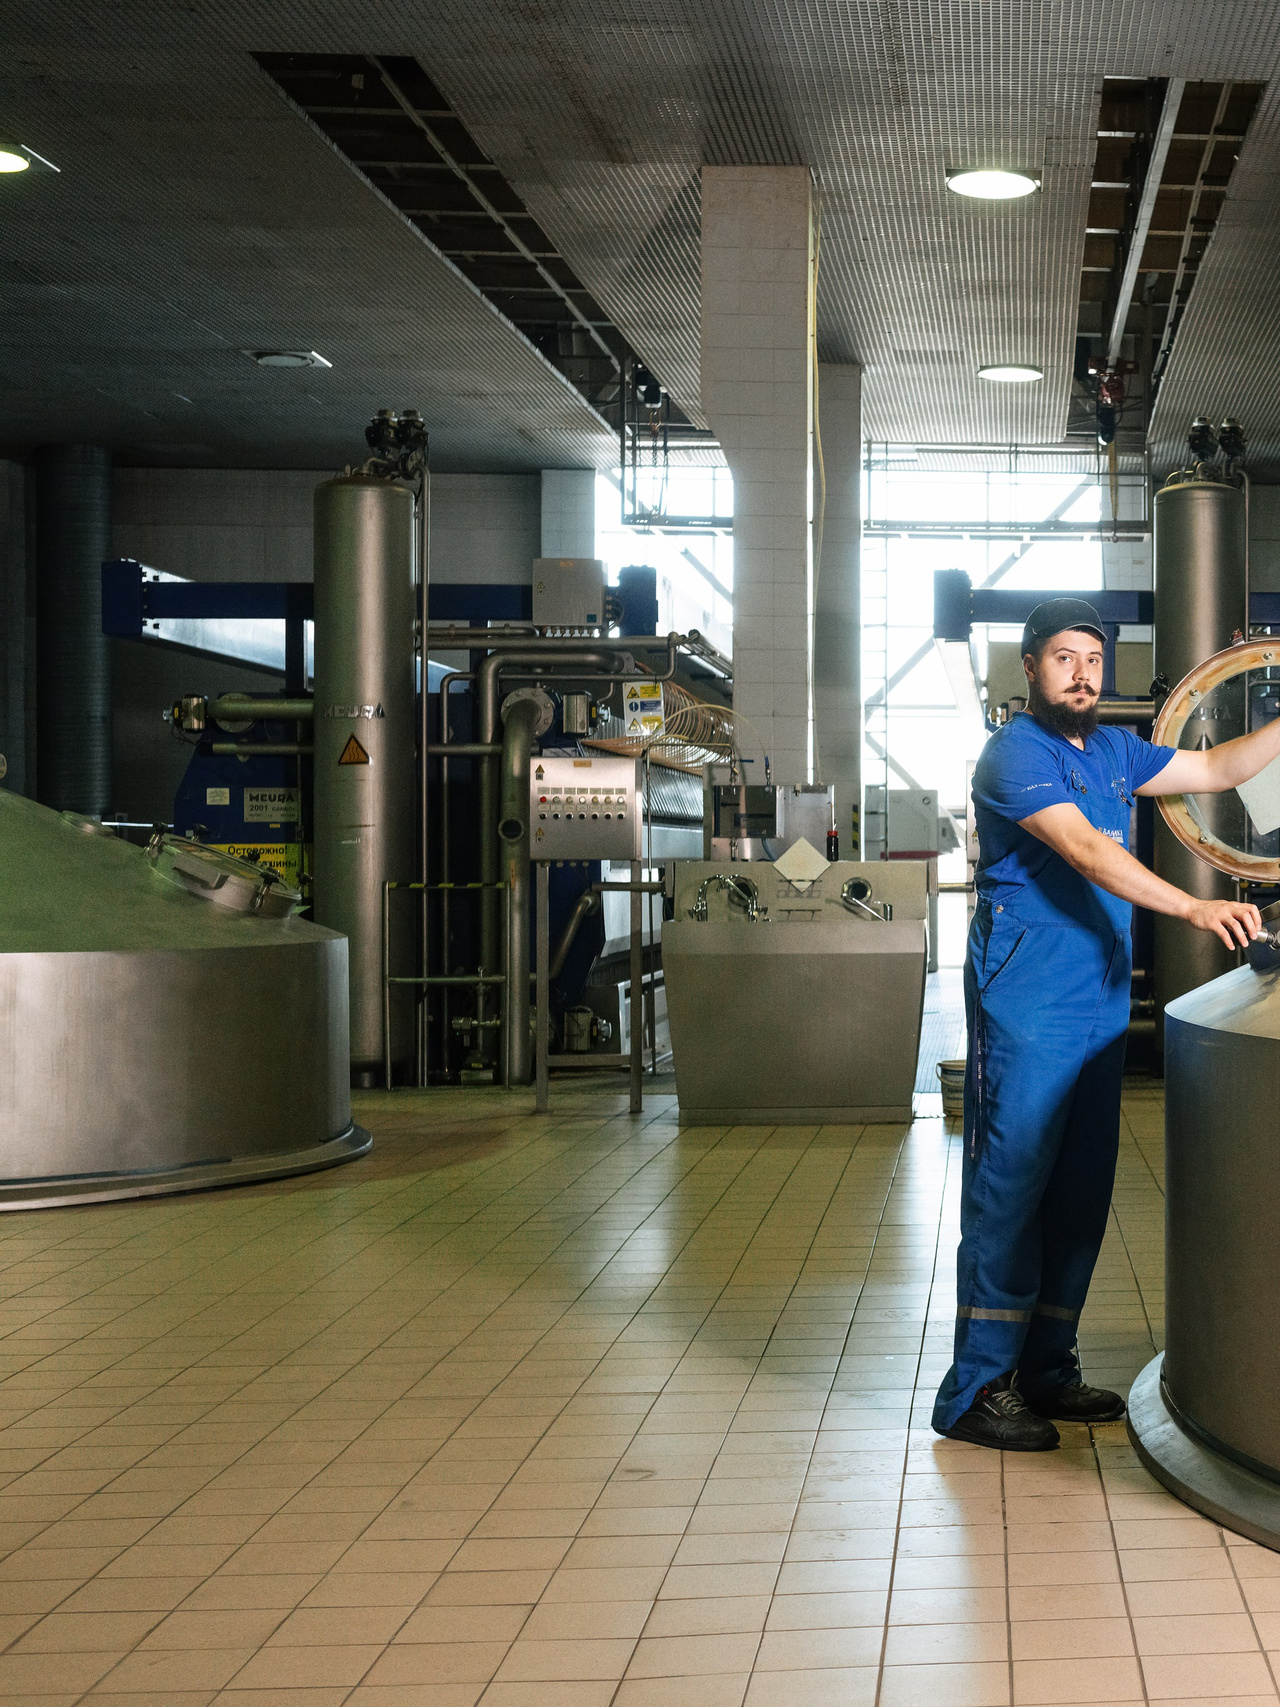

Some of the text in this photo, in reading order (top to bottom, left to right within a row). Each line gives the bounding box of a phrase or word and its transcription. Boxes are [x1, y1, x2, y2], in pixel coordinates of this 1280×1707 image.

[249, 792, 294, 804] MEURA
[249, 804, 268, 812] 2001
[227, 844, 288, 855] Осторожно!
